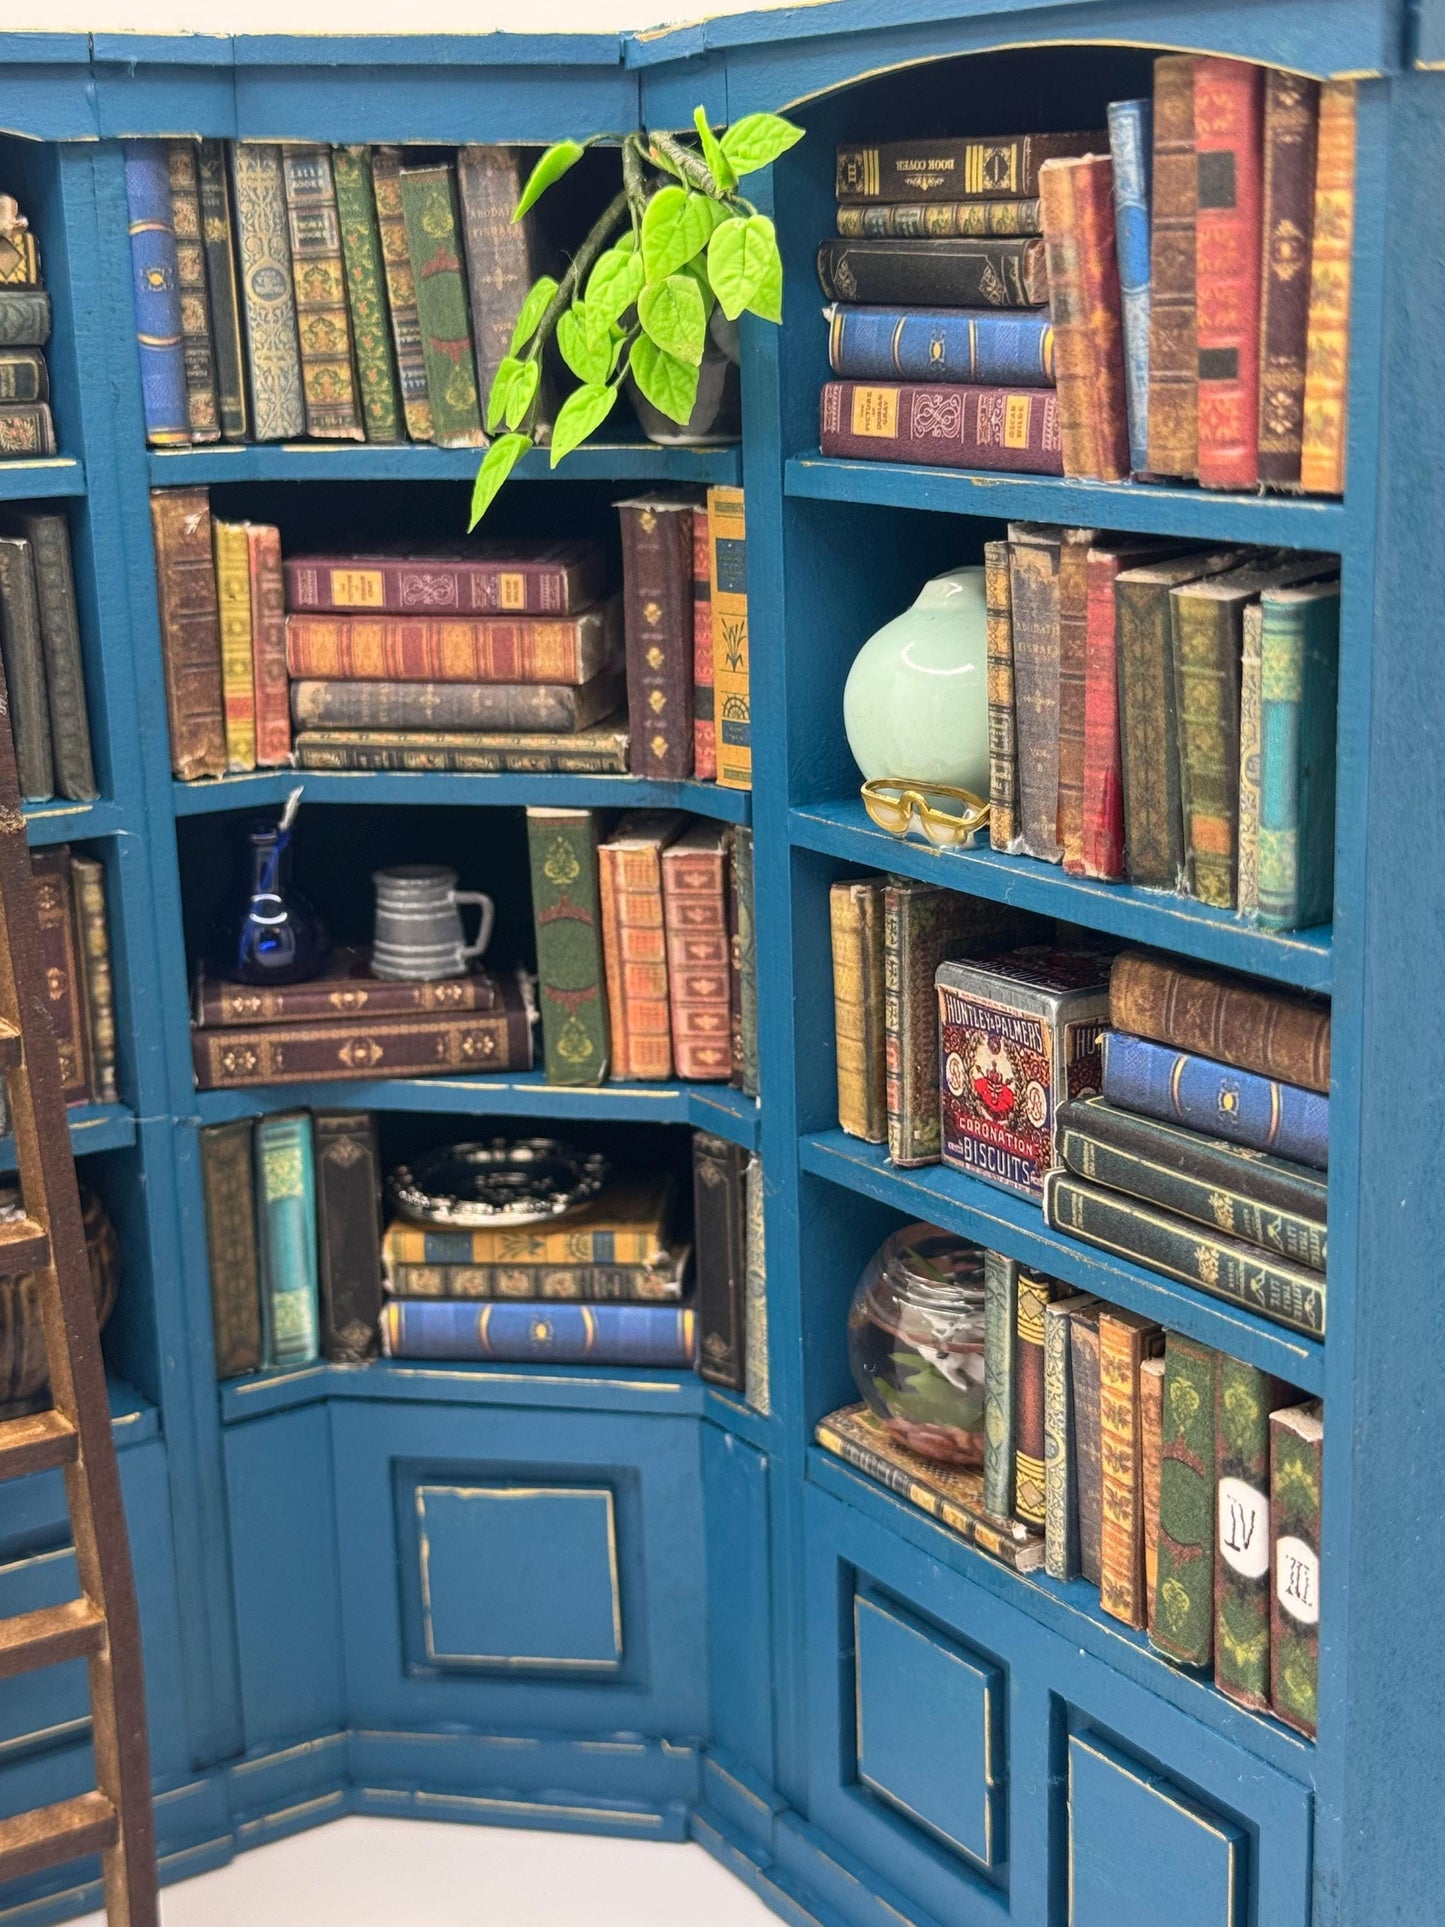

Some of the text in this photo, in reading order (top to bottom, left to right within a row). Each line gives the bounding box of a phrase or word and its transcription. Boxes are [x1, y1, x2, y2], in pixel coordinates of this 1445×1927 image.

[896, 159, 954, 171] BOOK COVER
[1016, 405, 1024, 438] WILDE
[945, 993, 990, 1030] HUNTLEY
[995, 1016, 1043, 1053] PALMERS
[959, 1118, 1033, 1156] CORONATION
[964, 1136, 1030, 1185] BISCUITS
